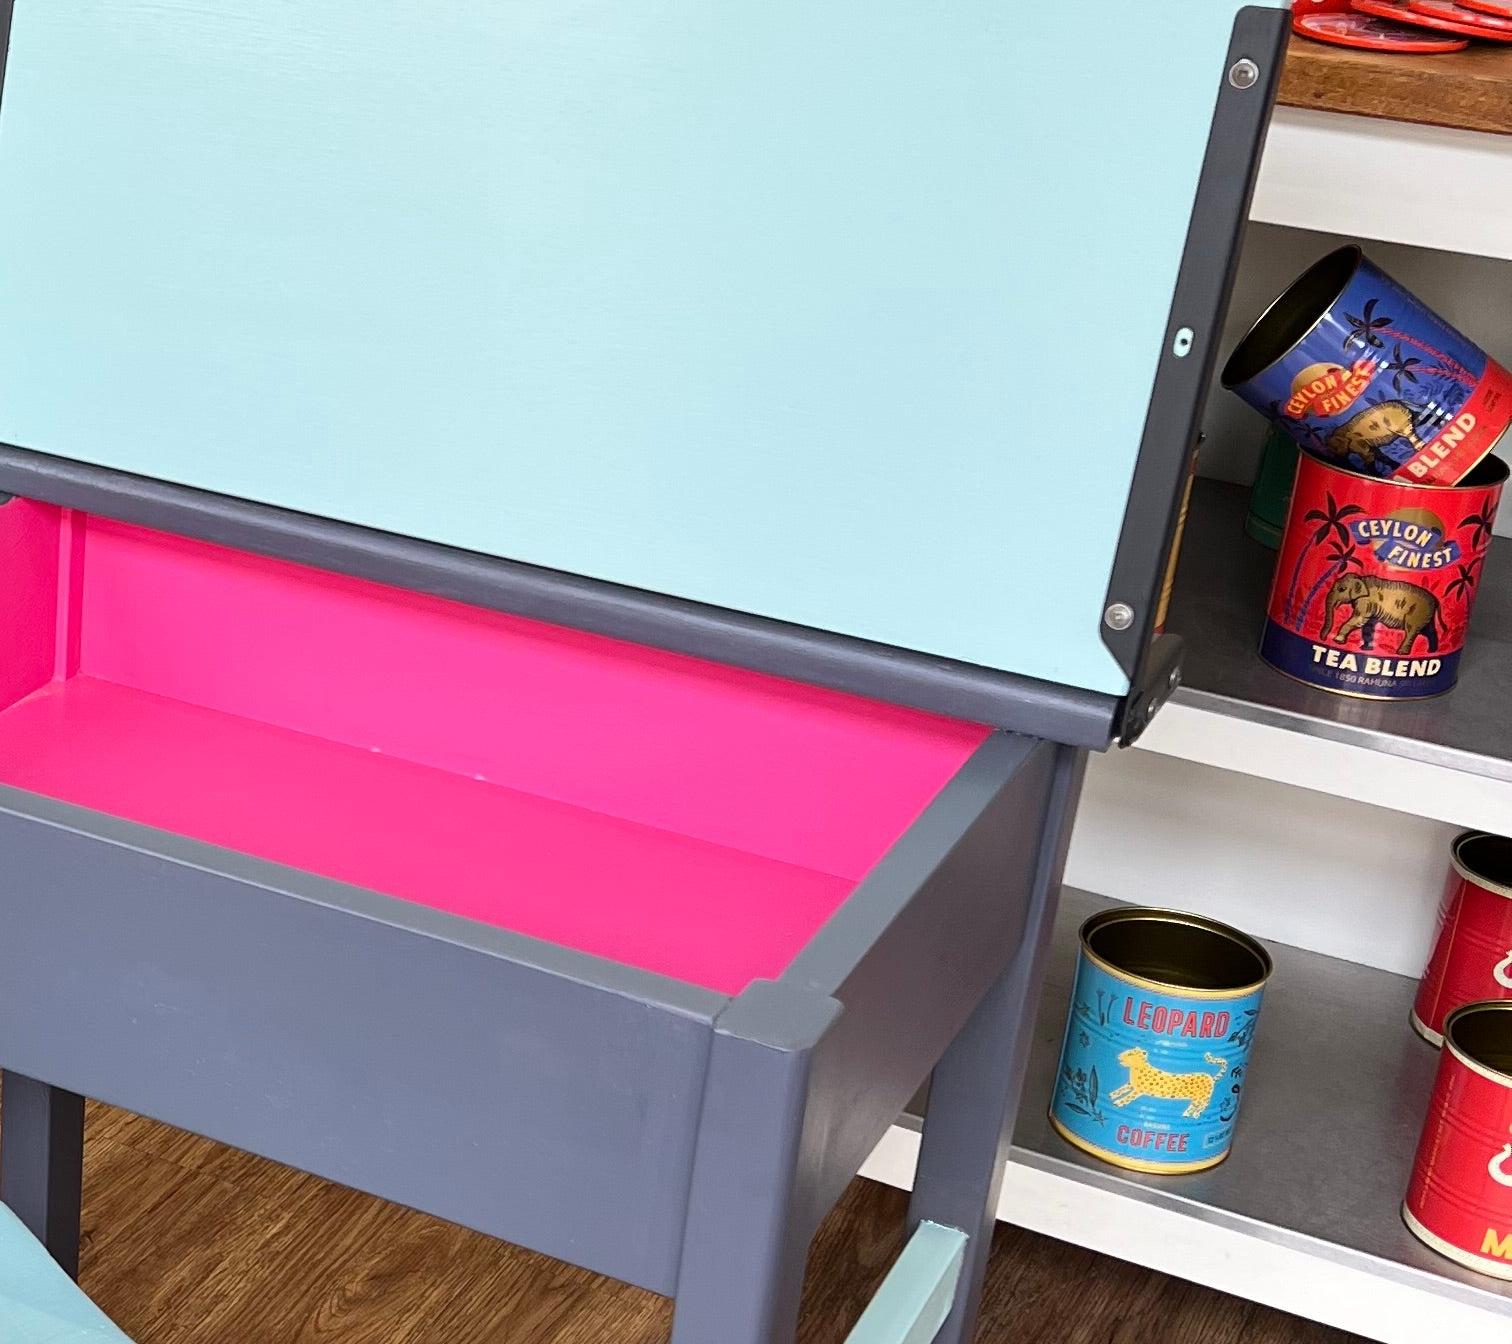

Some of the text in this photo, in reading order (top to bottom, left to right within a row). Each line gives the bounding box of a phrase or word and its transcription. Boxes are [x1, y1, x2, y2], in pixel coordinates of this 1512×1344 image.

[1286, 371, 1338, 417] CEYLON
[1407, 412, 1476, 479] BLEND
[1358, 519, 1434, 547] CEYLON
[1386, 542, 1454, 569] FINEST
[1311, 643, 1359, 675] TEA
[1364, 655, 1442, 678] BLEND
[1122, 995, 1231, 1039] LEOPARD
[1116, 1123, 1190, 1153] COFFEE
